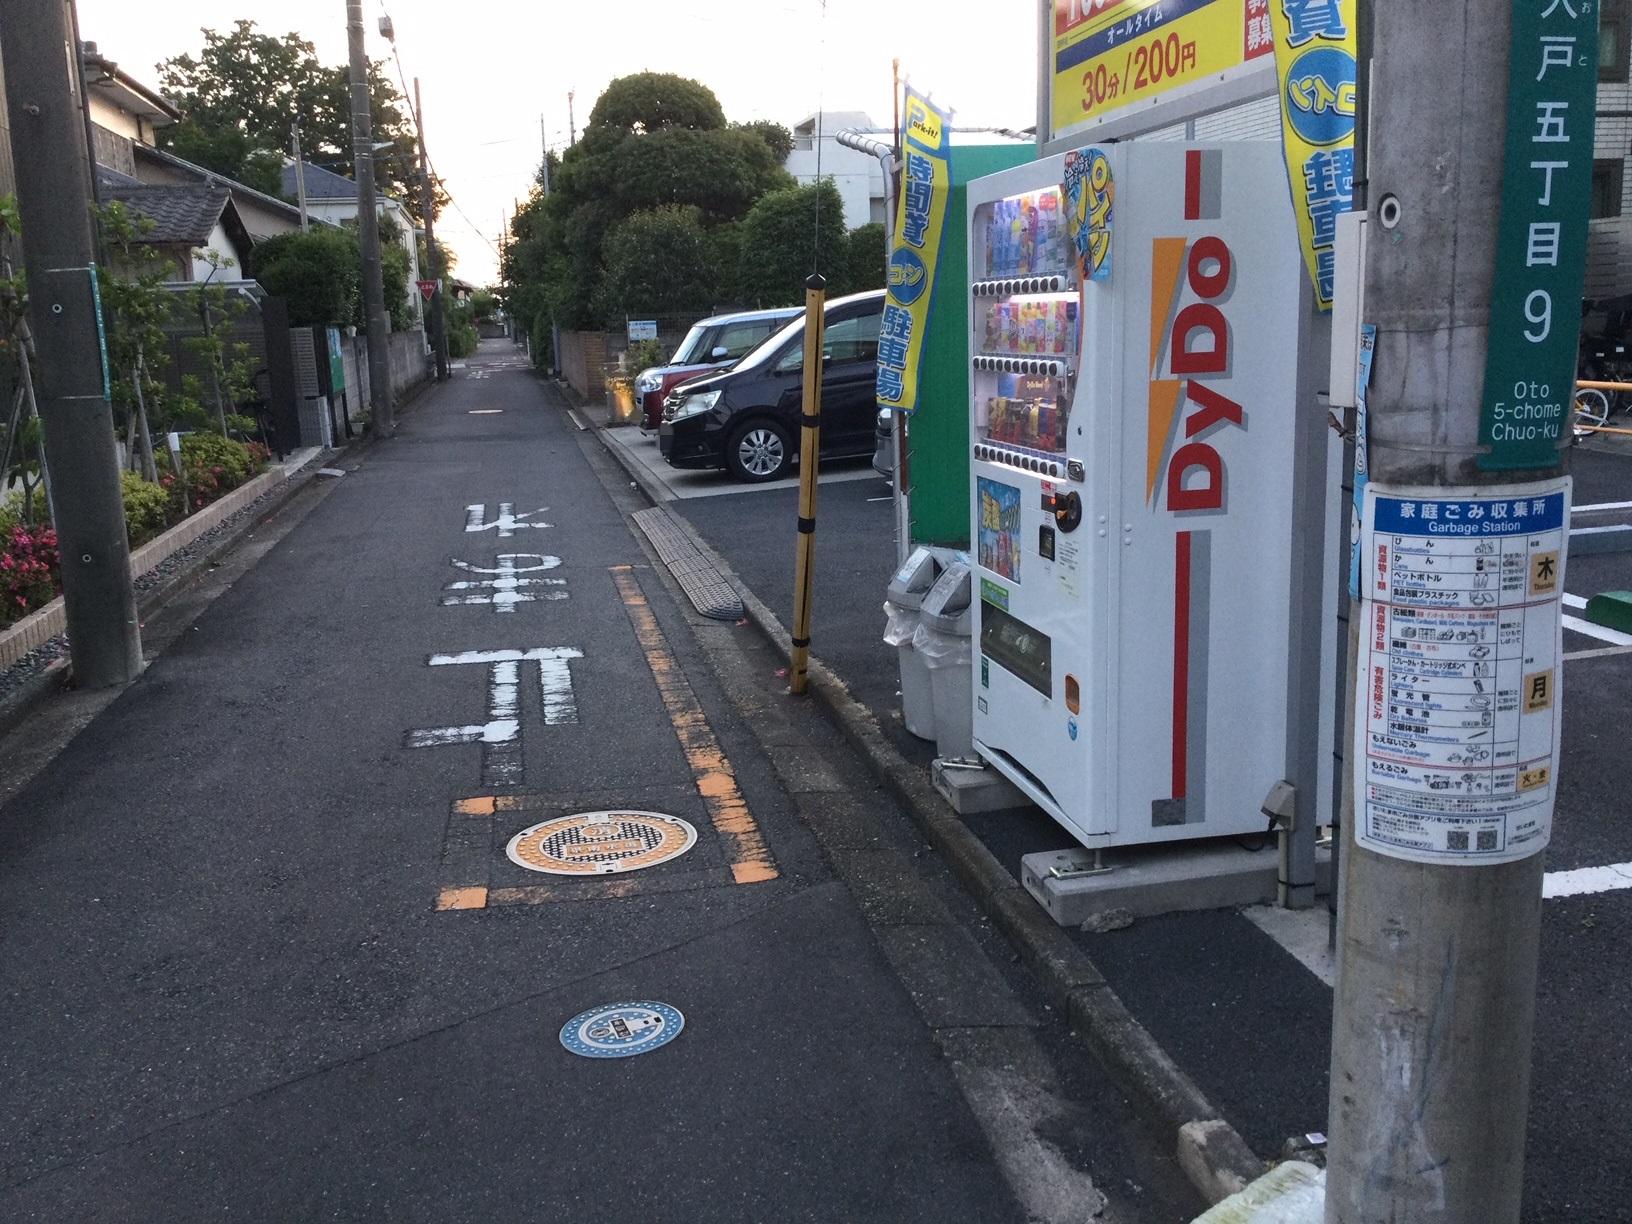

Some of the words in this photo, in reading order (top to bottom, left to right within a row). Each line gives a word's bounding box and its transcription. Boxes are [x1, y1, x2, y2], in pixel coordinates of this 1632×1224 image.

[1107, 5, 1163, 44] オールタイム
[1081, 31, 1196, 112] 30分/200円
[876, 303, 913, 401] 駐車場
[1514, 380, 1550, 400] Oto
[1493, 402, 1561, 421] 5-chome
[1491, 422, 1559, 441] Chuo-ku
[1400, 499, 1546, 519] 家庭ごみ収集所
[1428, 521, 1479, 535] Garbage
[1482, 520, 1521, 533] Station
[1537, 556, 1555, 580] 木
[1531, 674, 1547, 701] 月
